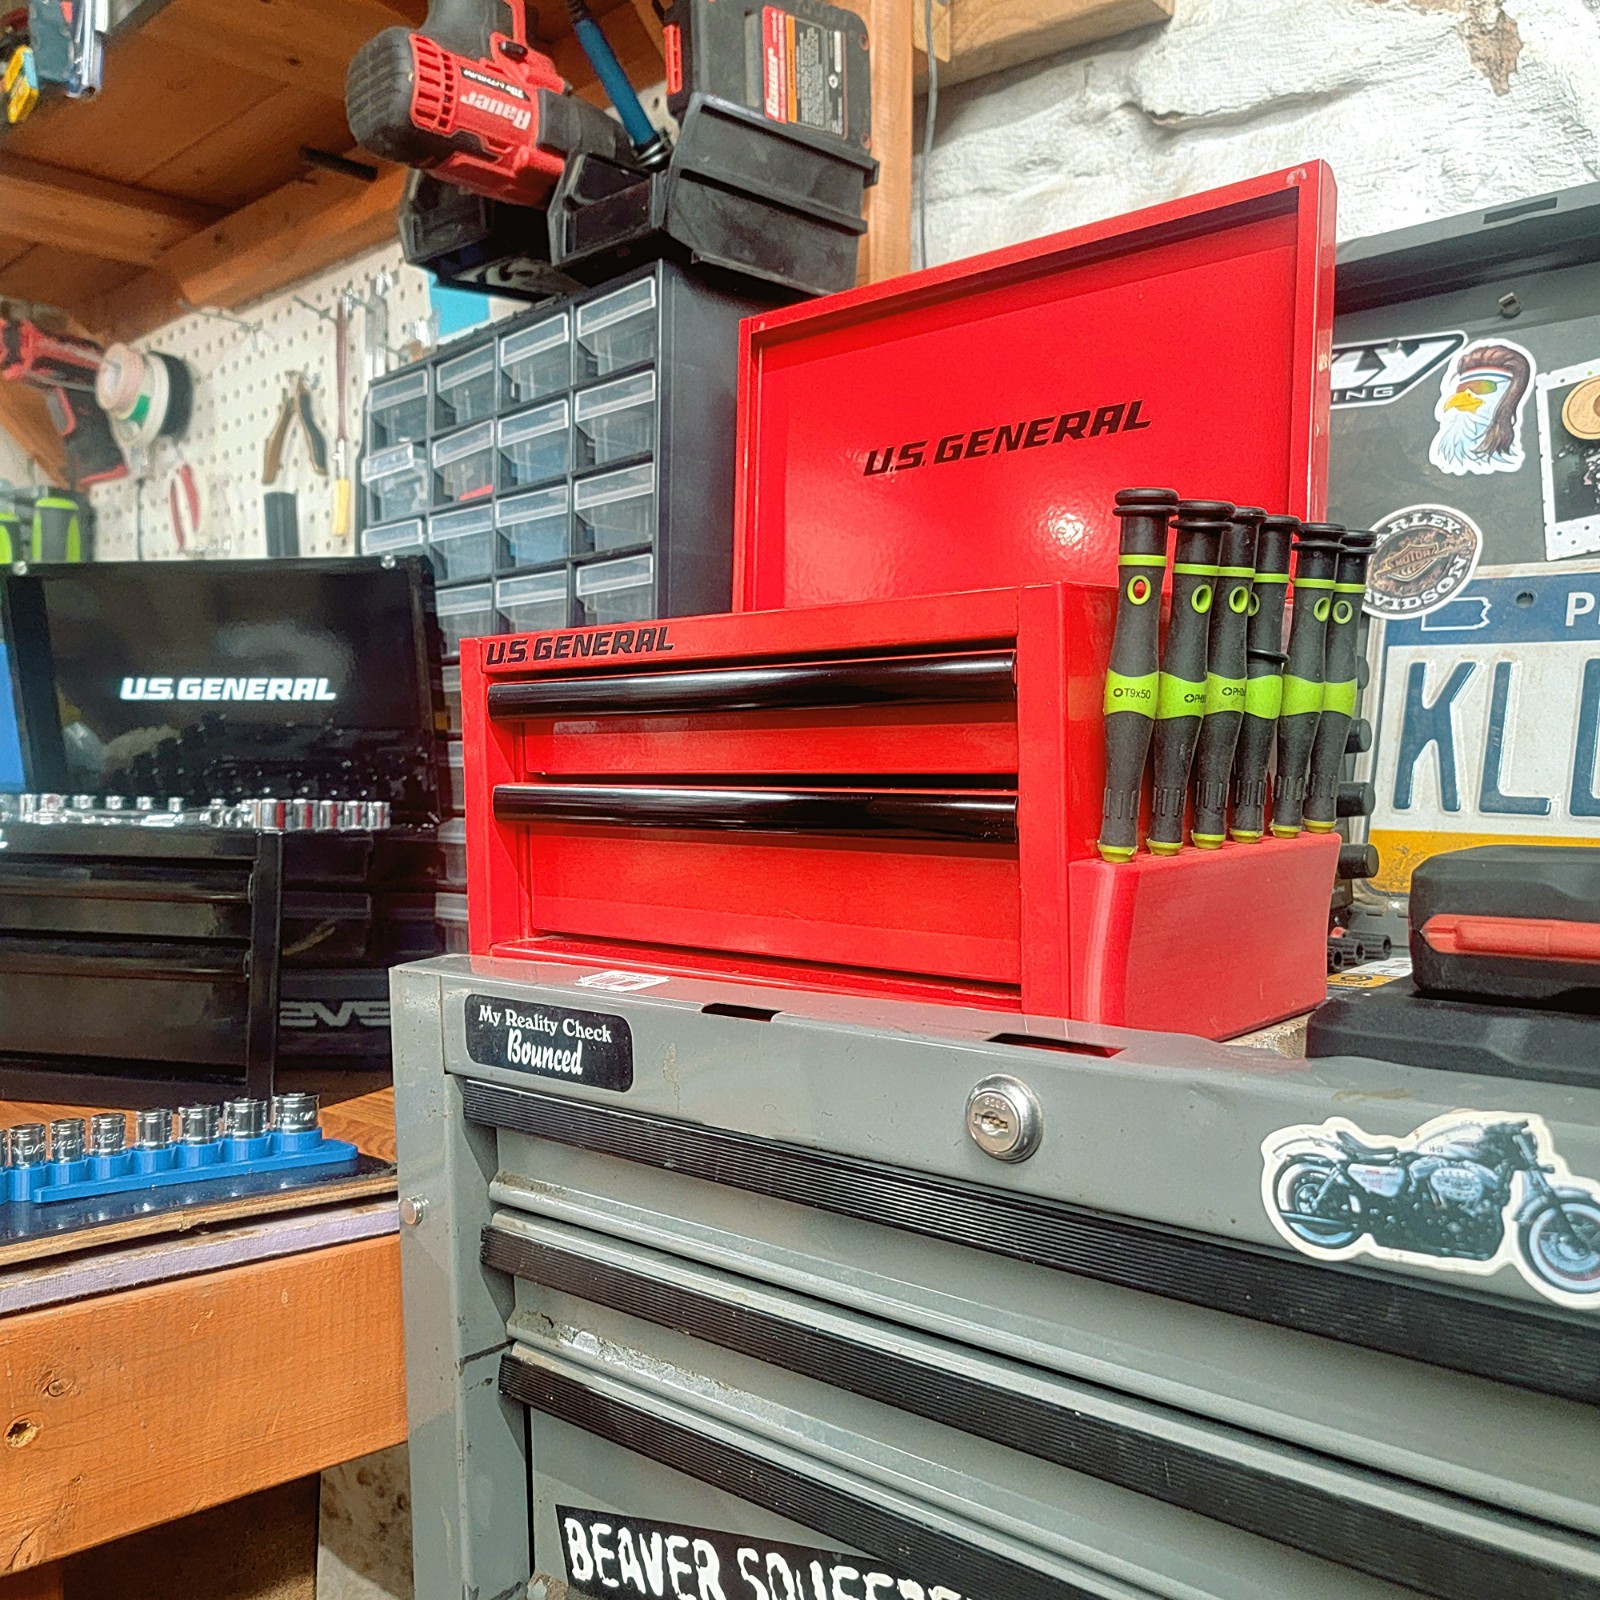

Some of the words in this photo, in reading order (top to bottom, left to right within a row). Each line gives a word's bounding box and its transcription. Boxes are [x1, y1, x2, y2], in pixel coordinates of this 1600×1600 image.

[765, 47, 779, 118] Bauer
[460, 92, 531, 130] Bauer
[1331, 340, 1457, 389] LY
[1333, 386, 1394, 402] ING
[864, 440, 927, 476] U.S.
[933, 400, 1151, 464] GENERAL
[1376, 513, 1461, 547] ARLEY
[1364, 555, 1467, 611] AVIDSON
[1565, 592, 1600, 627] P
[487, 639, 529, 665] U.S.
[533, 627, 674, 660] GENERAL
[177, 677, 336, 701] GENERAL
[1124, 687, 1150, 699] T9x50
[478, 1004, 501, 1027] My
[505, 1009, 558, 1037] Reality
[563, 1018, 612, 1043] Check
[507, 1028, 583, 1075] Bounced
[564, 1517, 723, 1600] BEAVER
